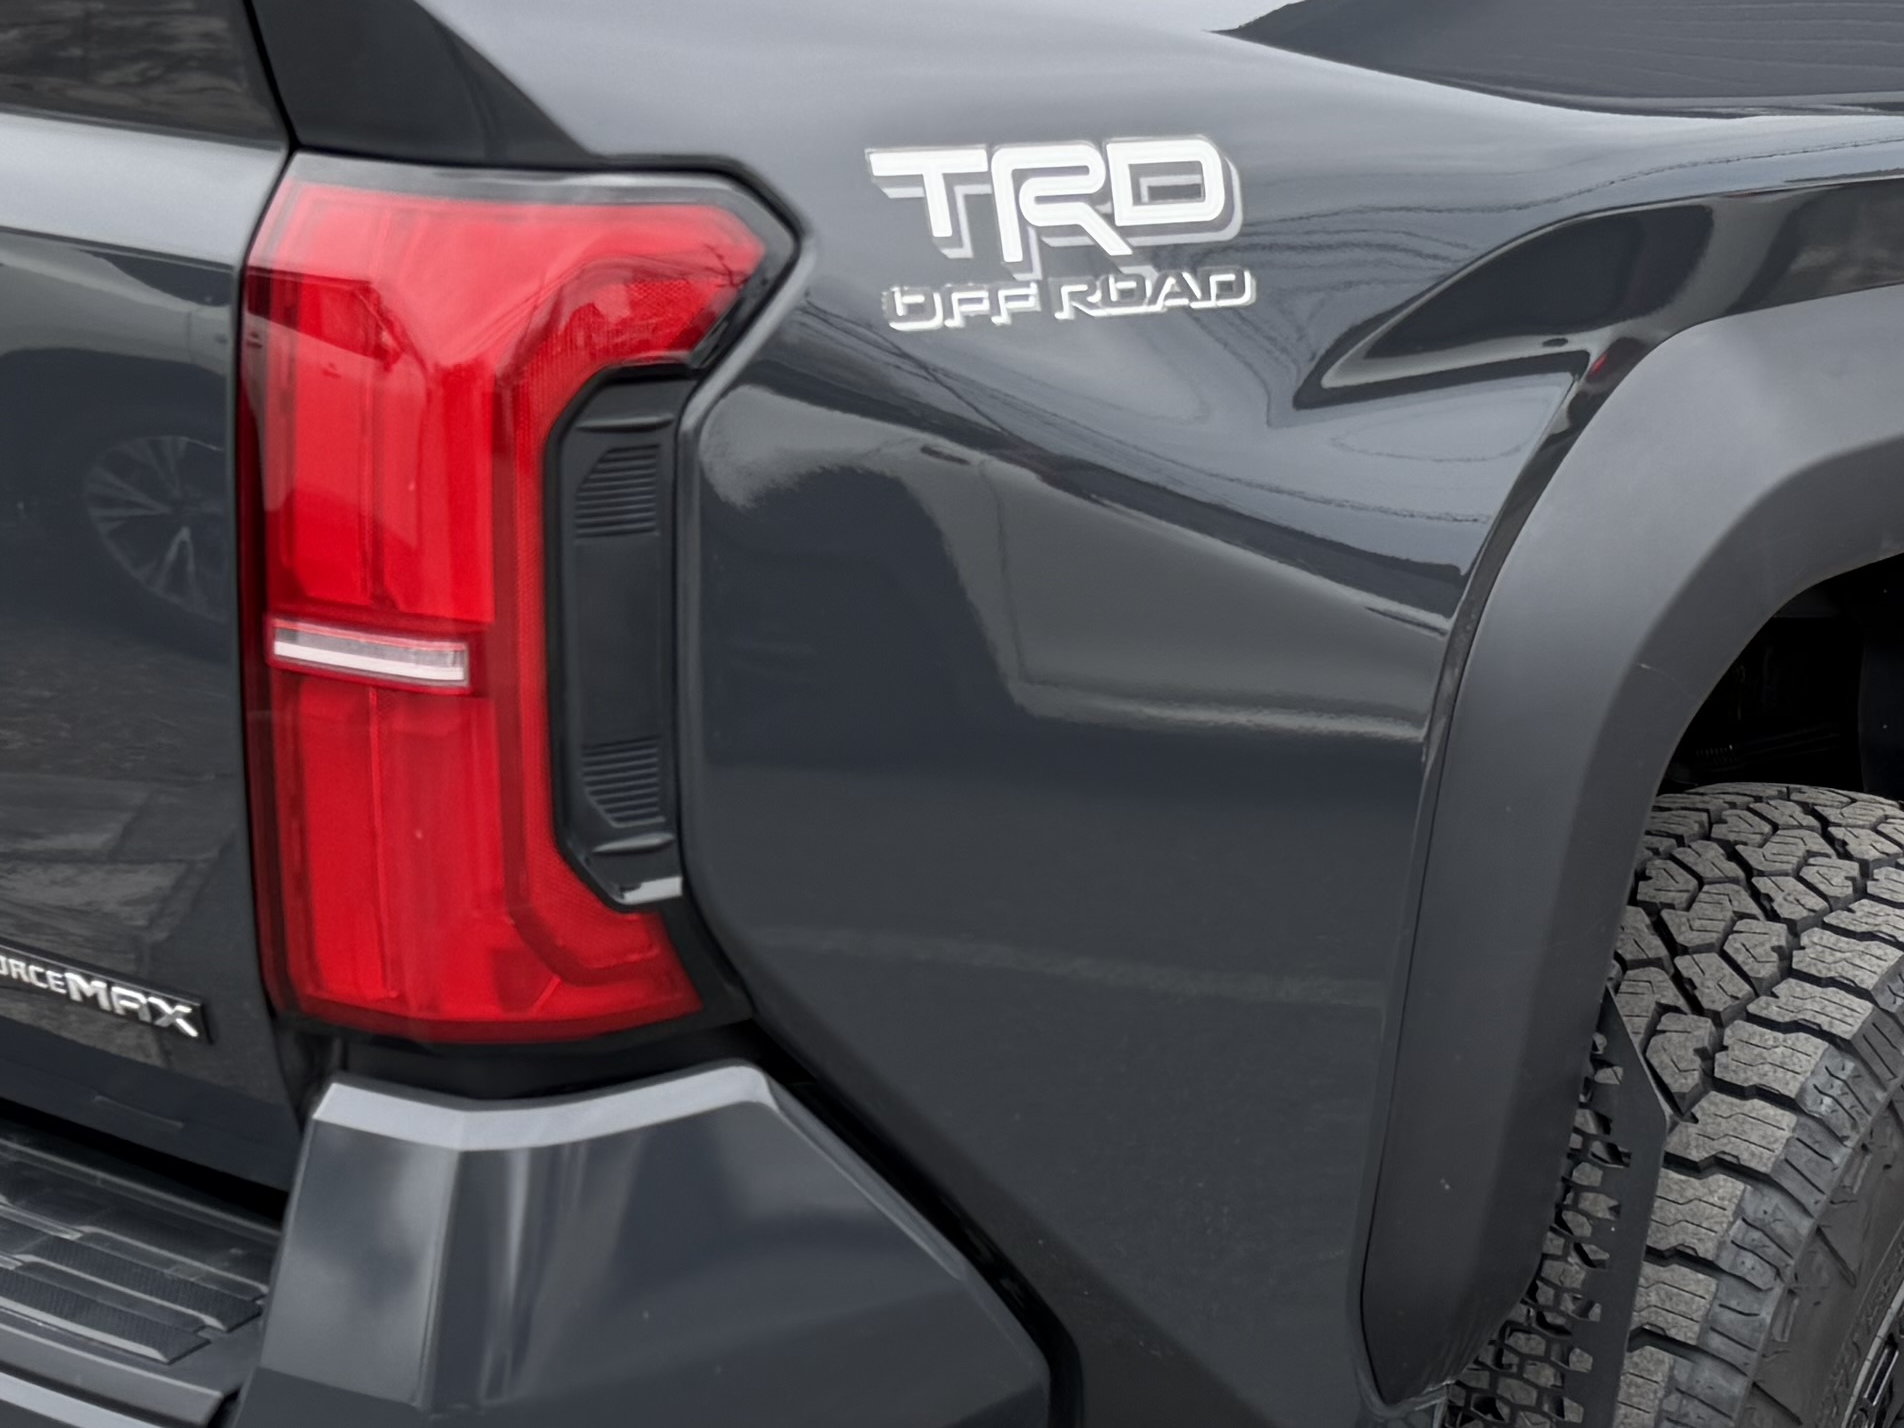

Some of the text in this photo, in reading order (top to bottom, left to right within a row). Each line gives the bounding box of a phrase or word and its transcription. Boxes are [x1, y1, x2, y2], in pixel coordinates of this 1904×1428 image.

[864, 135, 1244, 281] TRD
[882, 266, 1257, 331] OFF ROAD
